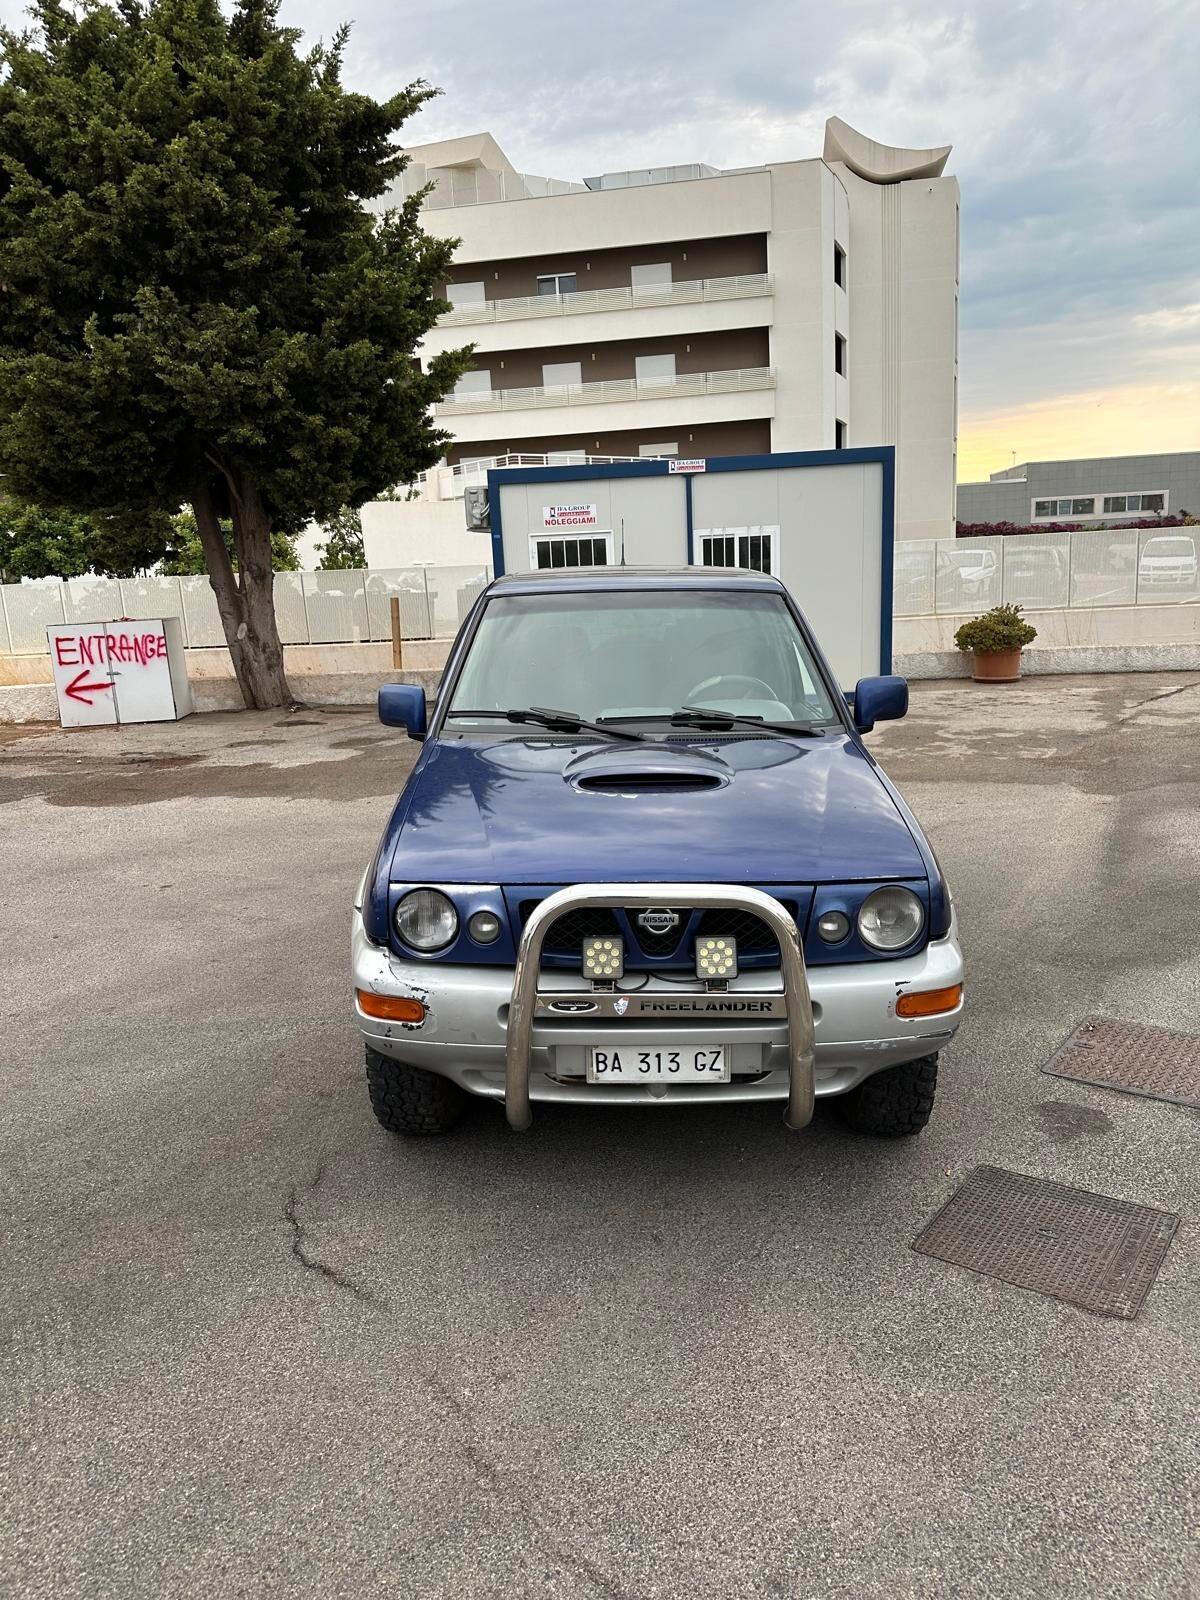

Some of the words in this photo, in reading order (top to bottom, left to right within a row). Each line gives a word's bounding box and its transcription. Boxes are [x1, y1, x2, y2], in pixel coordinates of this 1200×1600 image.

[544, 517, 596, 525] NOLEGGIAMI
[640, 1001, 772, 1011] FREELANDER
[595, 1052, 623, 1073] BA
[638, 1052, 681, 1073] 313
[694, 1050, 722, 1072] GZ
